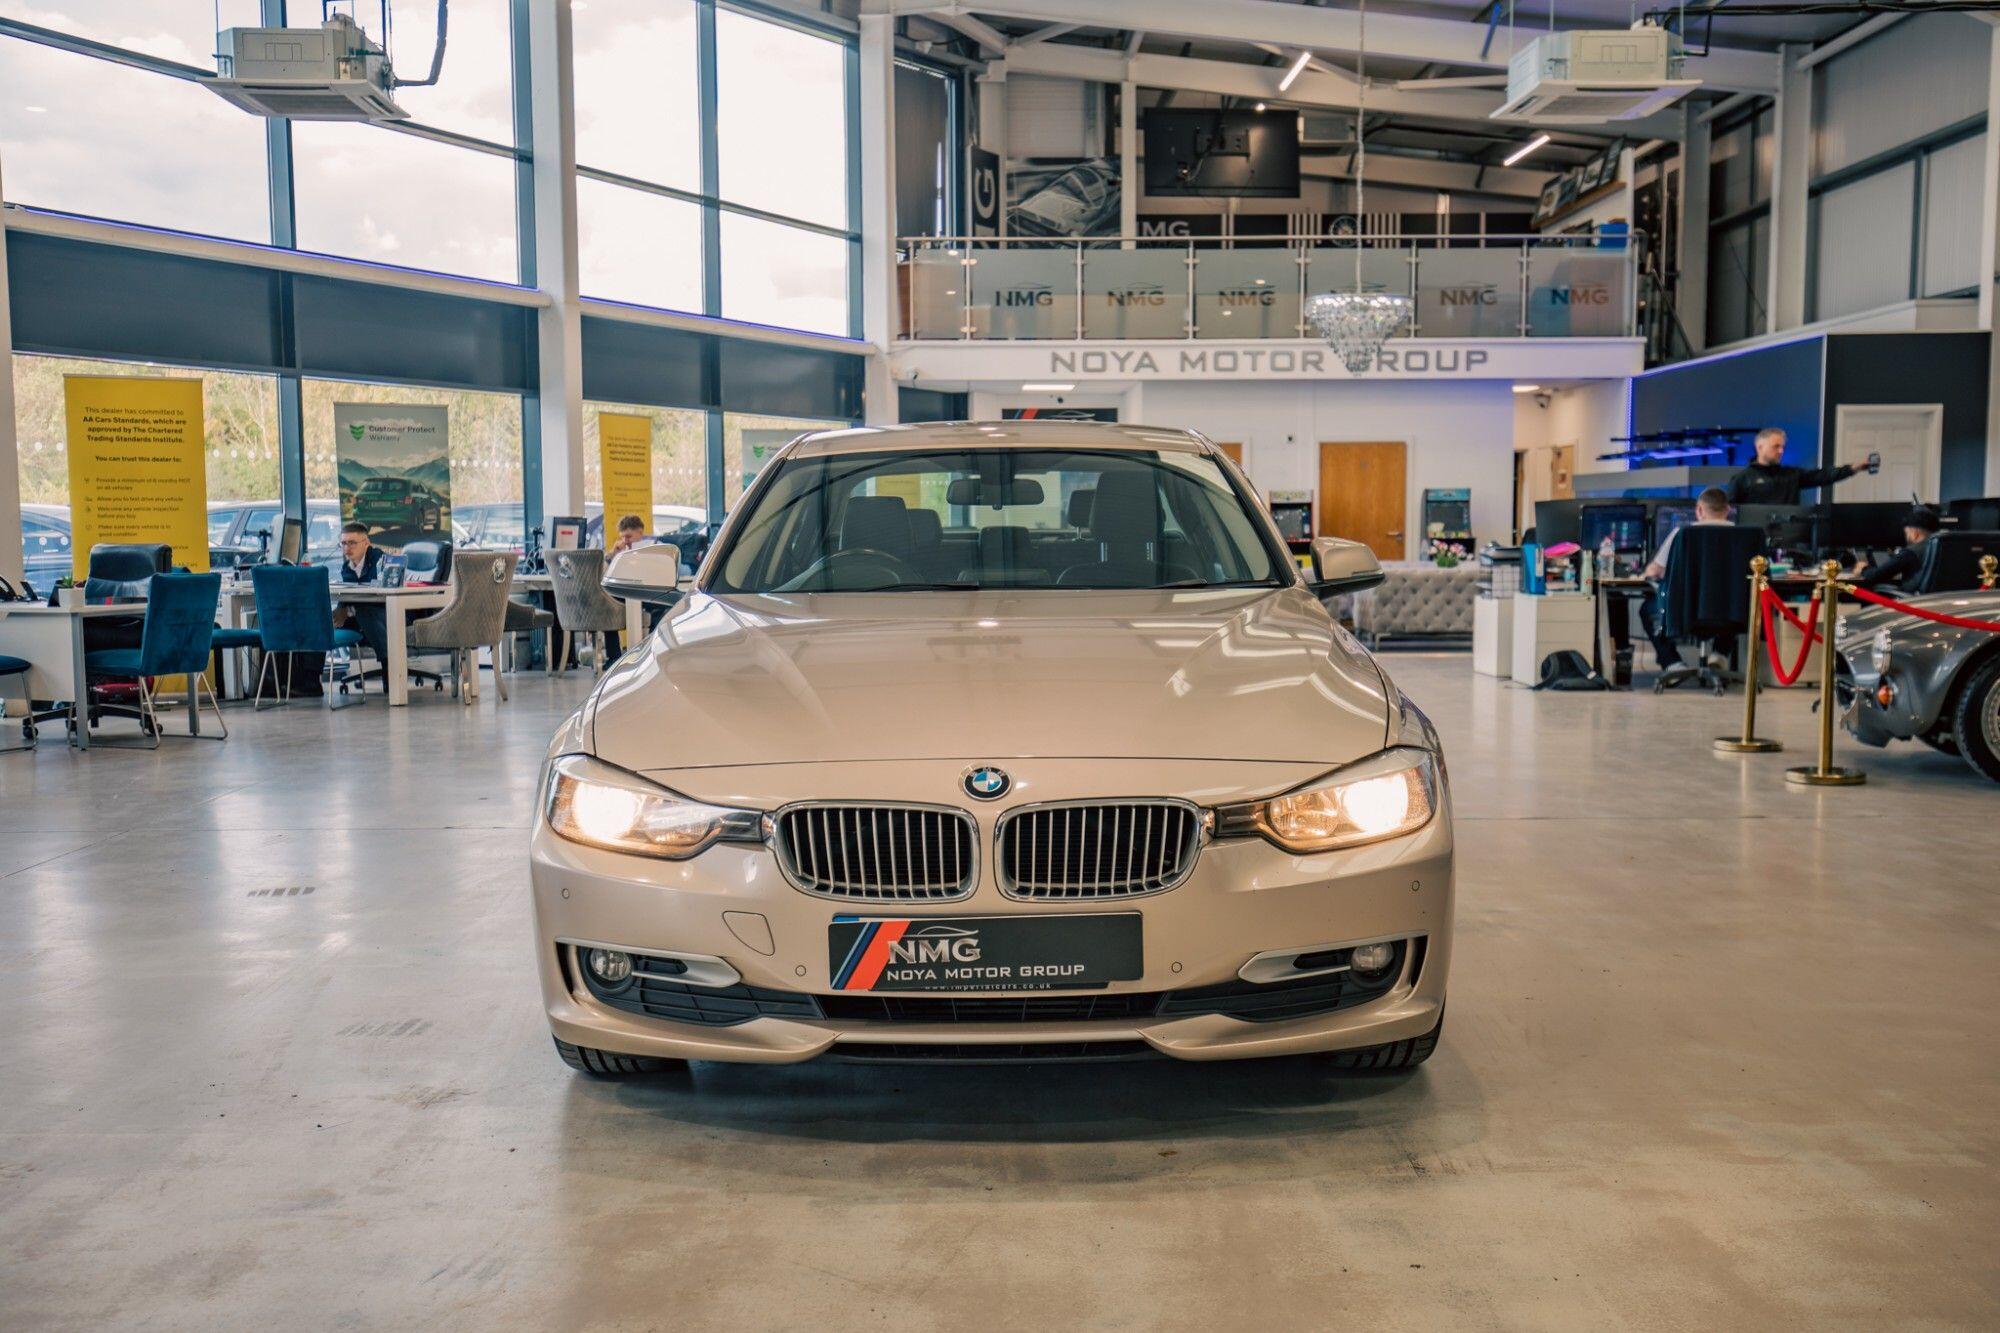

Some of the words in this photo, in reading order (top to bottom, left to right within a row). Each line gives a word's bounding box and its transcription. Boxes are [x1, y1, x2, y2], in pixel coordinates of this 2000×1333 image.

[1136, 221, 1190, 237] MG
[996, 290, 1053, 306] NMG
[1108, 290, 1165, 306] NMG
[1218, 290, 1276, 306] NMG
[1440, 289, 1498, 305] NMG
[1551, 288, 1610, 304] NMG
[1052, 350, 1159, 373] NOYA
[1180, 350, 1324, 372] MOTOR
[1346, 350, 1488, 372] ROUP
[888, 938, 981, 964] NMG
[887, 969, 937, 982] NOYA
[946, 966, 1011, 980] MOTOR
[1020, 964, 1084, 976] GROUP
